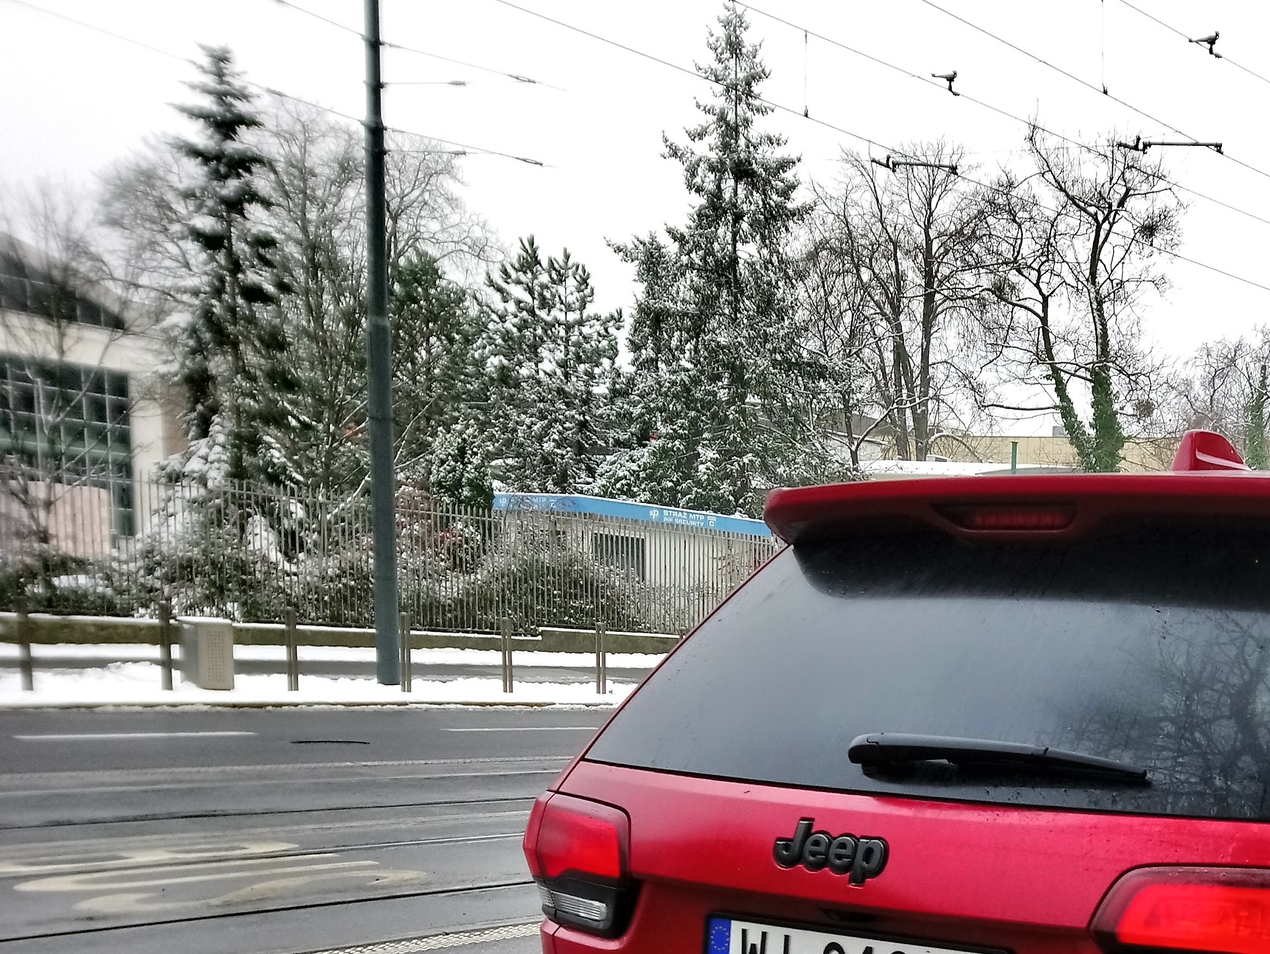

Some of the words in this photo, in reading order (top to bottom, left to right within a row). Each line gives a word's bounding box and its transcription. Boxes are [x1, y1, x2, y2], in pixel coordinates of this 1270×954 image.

[663, 509, 687, 518] STRAŻ
[689, 513, 705, 521] MTP
[675, 517, 704, 527] SECURITY
[773, 818, 888, 887] Jeep
